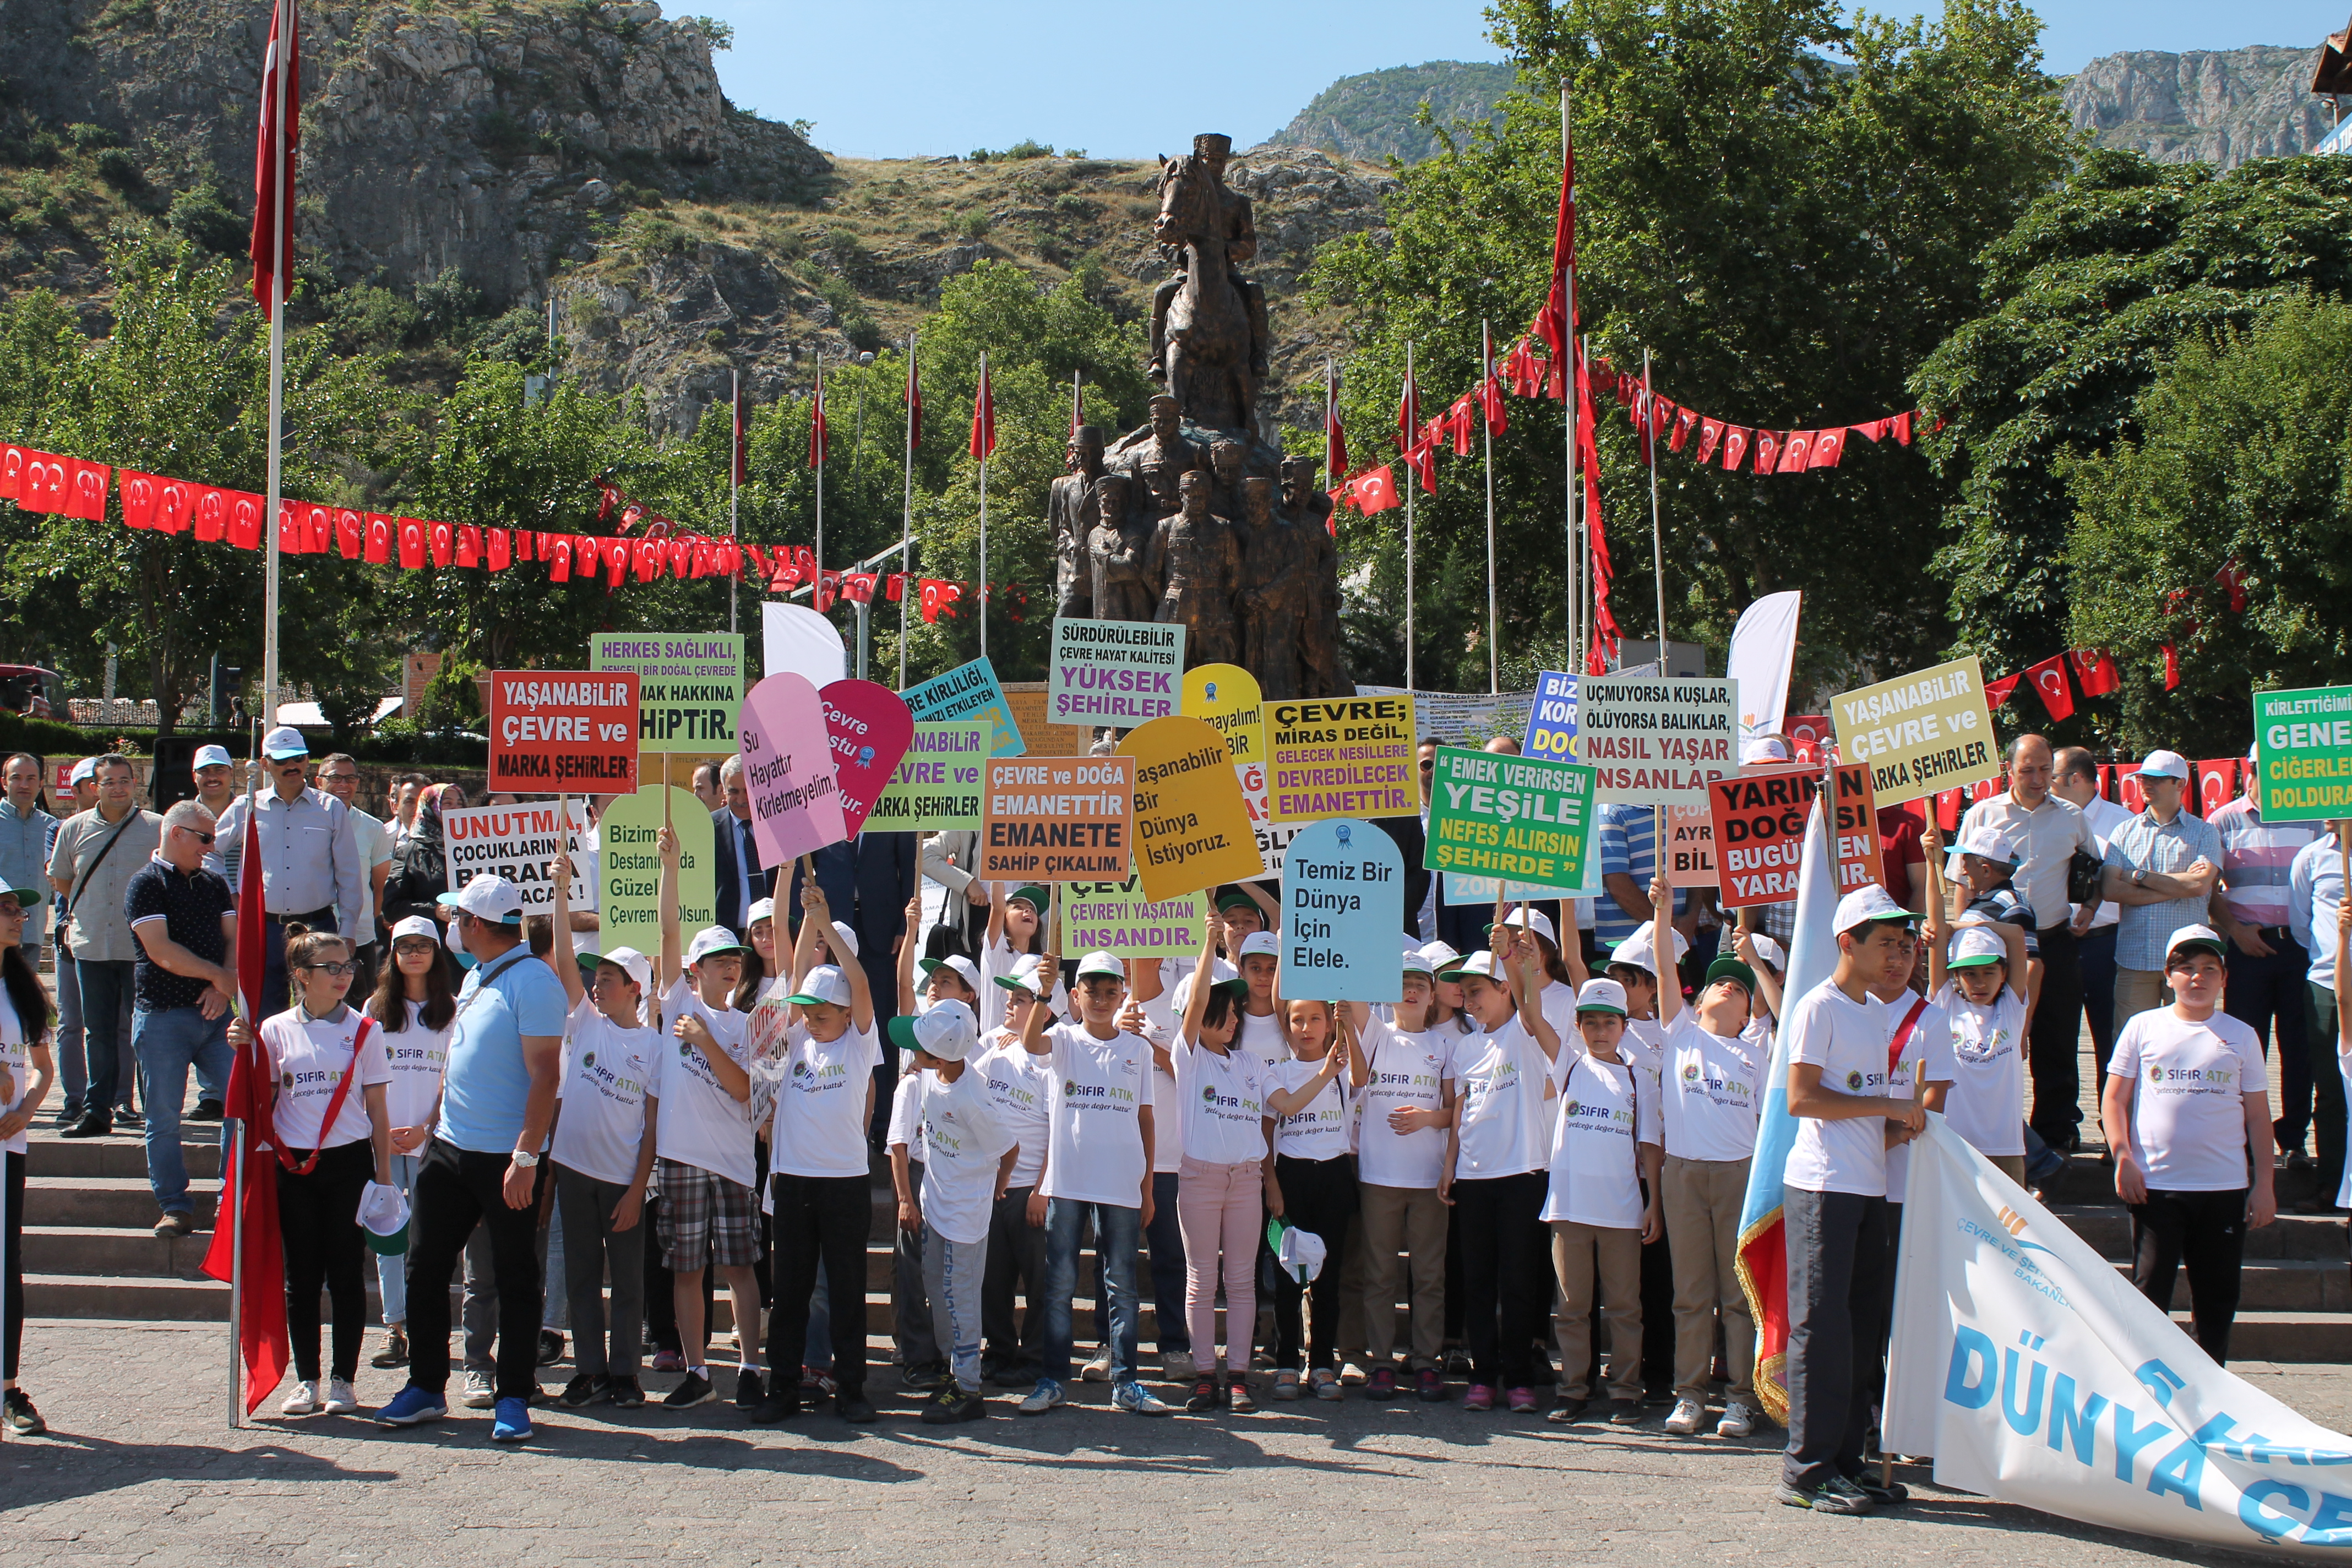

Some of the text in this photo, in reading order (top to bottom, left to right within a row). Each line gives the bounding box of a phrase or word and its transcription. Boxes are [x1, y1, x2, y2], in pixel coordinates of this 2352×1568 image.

[1062, 623, 1175, 647] SÜRDÜRÜLEBİLİR
[602, 638, 736, 662] HERKES SAĞLIKLI,
[1060, 646, 1175, 665] ÇEVRE HAYAT KALİTESİ
[643, 663, 736, 678] BİR DOĞAL ÇEVREDE
[1060, 663, 1172, 694] YÜKSEK
[671, 685, 734, 701] HAKKINA
[903, 664, 988, 714] RE KİRLİLİĞİ,
[1586, 684, 1730, 707] UÇMUYORSA KUŞLAR,
[945, 688, 995, 718] ETKİLEYEN
[1057, 692, 1171, 717] ŞEHİRLER
[1275, 700, 1406, 728] ÇEVRE;
[502, 715, 628, 747] ÇEVRE ve
[1586, 708, 1730, 734] ÖLÜYORSA BALIKLAR,
[743, 730, 760, 753] Su
[1275, 723, 1408, 745] MİRAS DEĞİL,
[1851, 710, 1977, 762] ÇEVRE ve
[1276, 743, 1408, 764] GELECEK NESİLLERE
[1588, 736, 1729, 765] NASIL YAŞAR
[497, 754, 551, 777] MARKA
[954, 767, 979, 783] ve
[992, 761, 1125, 790] ÇEVRE ve DOĞA
[1134, 747, 1223, 785] aşanabilir
[1278, 763, 1410, 788] DEVREDİLECEK
[1451, 756, 1499, 783] EMEK
[755, 774, 836, 821] Kirletmeyelim.
[1133, 791, 1159, 813] Bir
[1279, 785, 1412, 815] EMANETTİR.
[1719, 769, 1864, 811] YARINN
[992, 790, 1123, 815] EMANETTİR
[449, 810, 582, 840] UNUTMA,
[610, 825, 657, 843] Bizim
[990, 823, 1122, 847] EMANETE
[1139, 813, 1199, 840] Dünya
[1725, 804, 1867, 843] DOĞSI
[1439, 818, 1580, 857] NEFES ALIRSIN
[1146, 834, 1231, 866] İstiyoruz.
[1727, 834, 1871, 872] BUGÜEN
[988, 852, 1122, 875] SAHİP ÇIKALIM.
[1295, 859, 1392, 881] Temiz Bir
[610, 878, 658, 896] Güzel
[1070, 899, 1194, 925] ÇEVREYİ YAŞATAN
[1295, 888, 1360, 914] Dünya
[1294, 913, 1331, 943] İçin
[1294, 947, 1349, 968] Elele.
[397, 1048, 423, 1059] SIFIR
[296, 1071, 326, 1084] SIFIR
[1381, 1073, 1437, 1088] SIFIR ATIK
[2167, 1069, 2233, 1084] SIFIR ATIK
[989, 1079, 1035, 1104] SIFIR ATIK
[1077, 1085, 1134, 1102] SIFIR ATIK
[1215, 1096, 1238, 1107] IFIR
[1396, 1090, 1416, 1098] değer
[1091, 1102, 1112, 1111] değer
[1580, 1104, 1609, 1119] SIFIR
[1288, 1113, 1316, 1125] SIFIR
[1594, 1124, 1614, 1133] değer
[1957, 1217, 2018, 1260] ÇEVRE VE
[1944, 1323, 2207, 1512] DÜNYA
